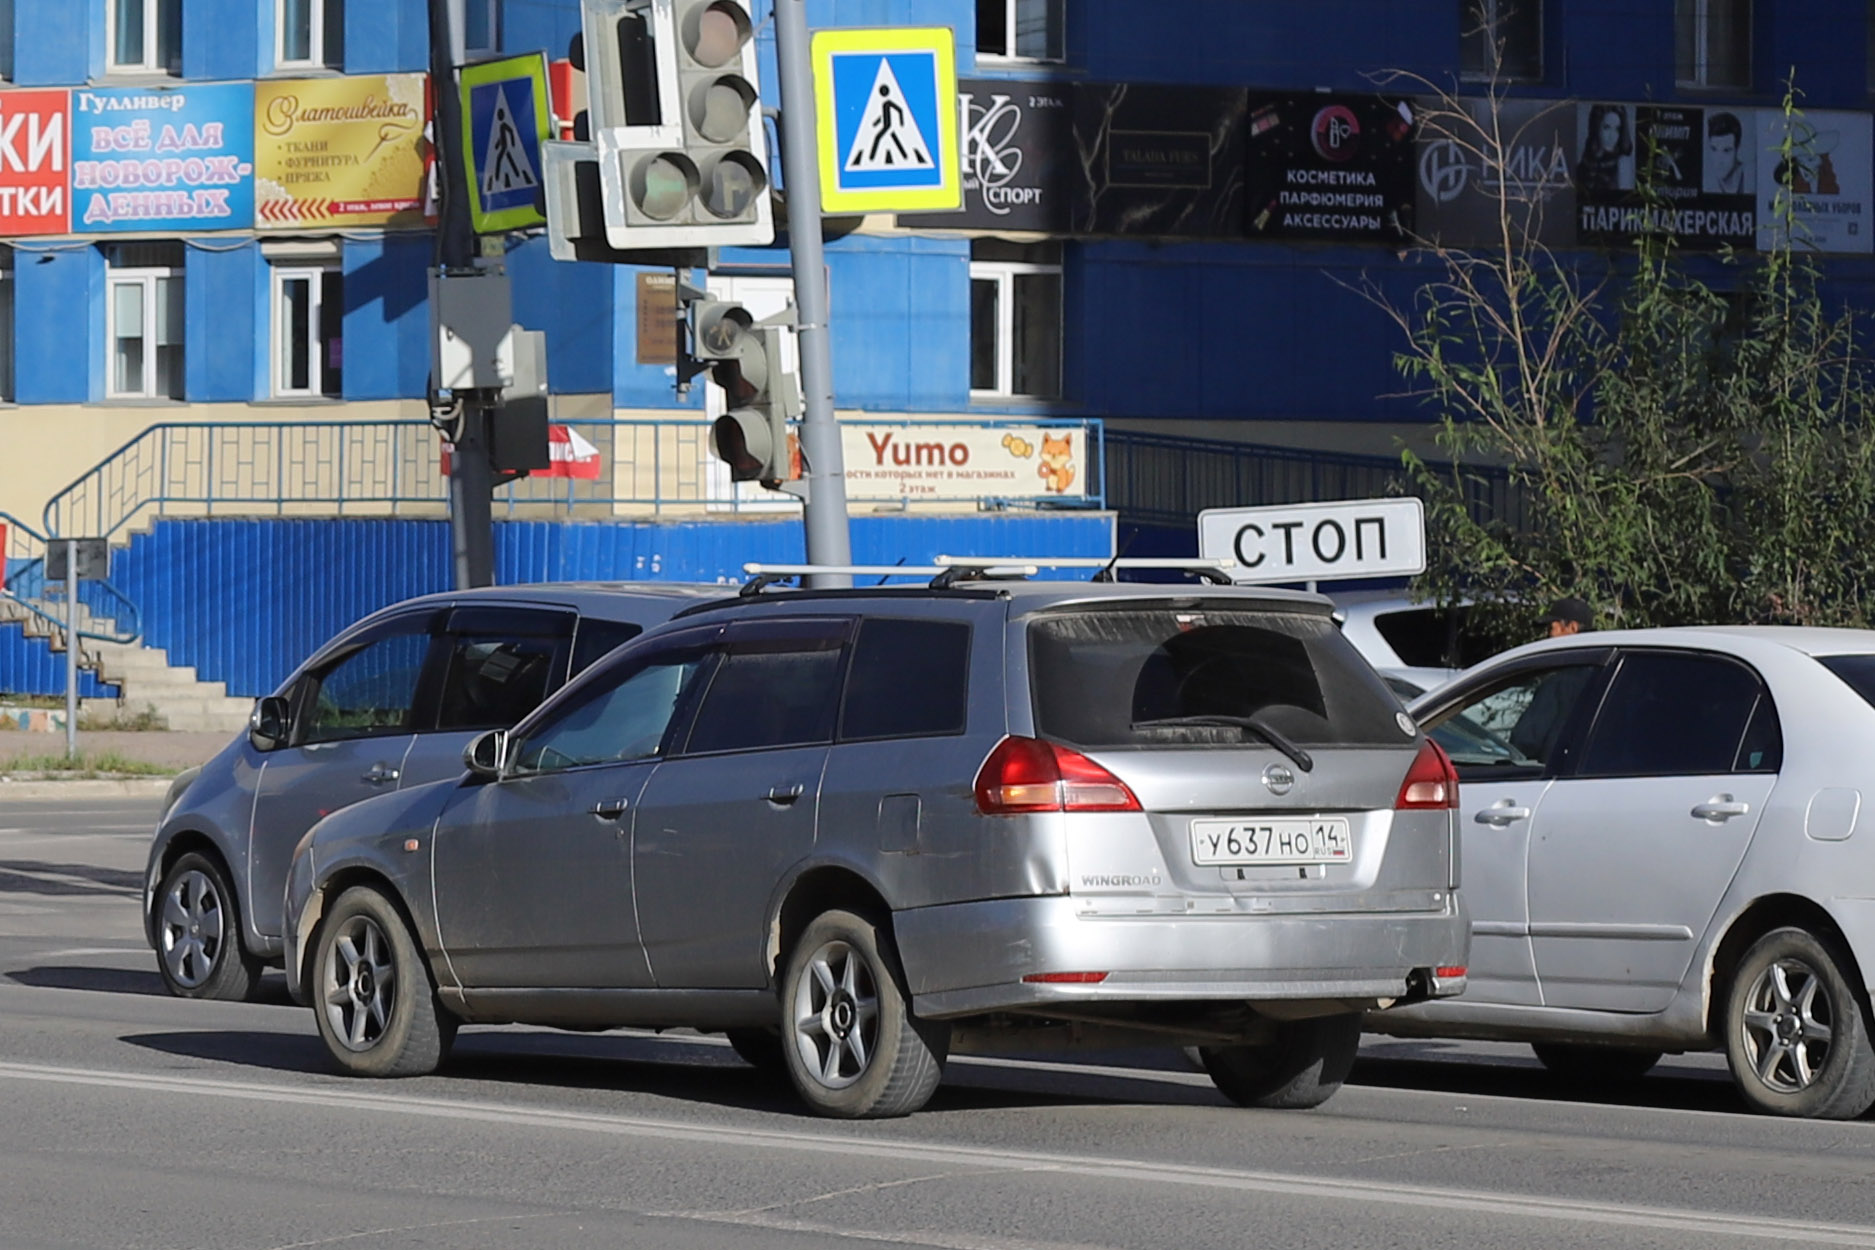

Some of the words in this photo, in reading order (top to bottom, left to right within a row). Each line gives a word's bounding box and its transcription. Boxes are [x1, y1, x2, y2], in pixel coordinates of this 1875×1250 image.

[79, 93, 185, 114] Гулливер
[263, 95, 409, 136] Златошвейка
[91, 119, 151, 153] ВСЁ
[156, 122, 223, 153] ДЛЯ
[286, 141, 328, 153] ТКАНИ
[285, 155, 359, 168] ФУРНИТУРА
[74, 156, 252, 188] НОВОРОЖ-
[286, 171, 331, 183] ПРЯЖА
[1286, 169, 1376, 186] КОСМЕТИКА
[989, 187, 1043, 204] СПОРТ
[1280, 191, 1384, 207] ПАРФЮМЕРИЯ
[84, 189, 231, 224] ДЕННЫХ
[1283, 213, 1382, 229] АКСЕССУАРЫ
[867, 433, 969, 466] Yumo
[874, 470, 922, 483] которых
[926, 470, 944, 479] нет
[947, 471, 954, 479] в
[956, 470, 1016, 480] магазинах
[899, 483, 906, 493] 2
[908, 485, 935, 494] этаж
[1234, 516, 1387, 568] СТОП
[1316, 824, 1339, 847] 14
[1081, 875, 1162, 887] WINGROAD
